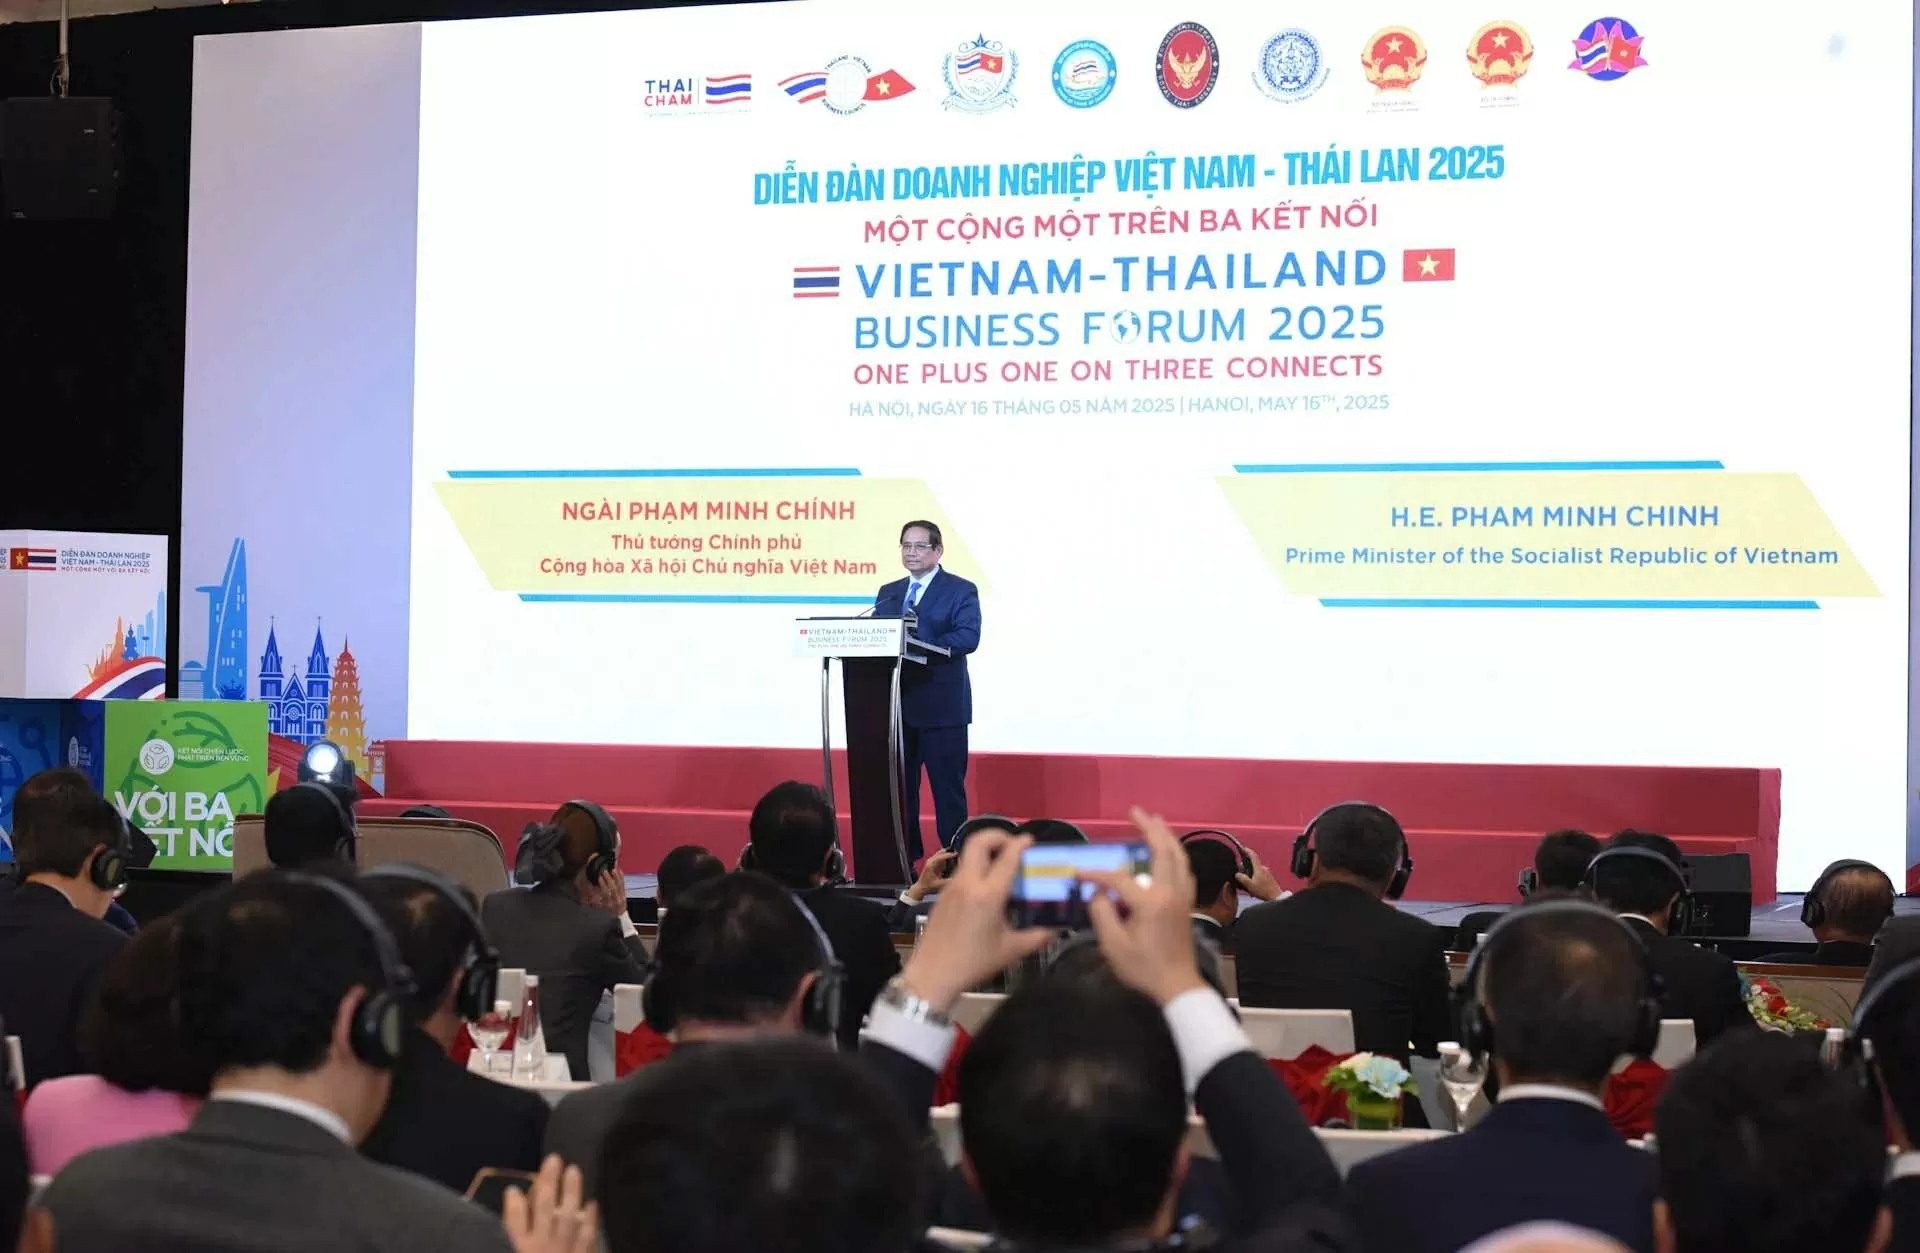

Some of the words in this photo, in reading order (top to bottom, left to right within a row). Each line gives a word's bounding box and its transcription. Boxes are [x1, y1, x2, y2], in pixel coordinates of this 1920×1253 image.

[645, 79, 692, 93] THAI
[644, 94, 692, 106] CHAM
[754, 160, 818, 205] DIỄN
[826, 163, 884, 202] ĐÀN
[893, 164, 990, 200] DOANH
[999, 153, 1105, 201] NGHIỆP
[1115, 151, 1175, 198] VIỆT
[1183, 154, 1255, 189] NAM
[1284, 143, 1350, 186] THÁI
[1360, 148, 1420, 183] LAN
[1428, 144, 1504, 180] 2025
[864, 215, 928, 246] MỘT
[937, 213, 1025, 244] CỘNG
[1034, 209, 1101, 241] MỘT
[1110, 206, 1189, 235] TRÊN
[1200, 208, 1242, 231] BA
[1252, 199, 1311, 229] KẾT
[1321, 196, 1377, 228] NỐI
[856, 250, 1385, 298] VIETNAM-THAILAND
[856, 313, 1059, 348] BUSINESS
[1084, 308, 1244, 344] FORUM
[1269, 305, 1384, 340] 2025
[854, 364, 909, 384] ONE
[922, 362, 987, 384] PLUS
[1001, 361, 1058, 382] ONE
[1071, 360, 1111, 381] ON
[1125, 358, 1213, 380] THREE
[1227, 354, 1382, 378] CONNECTS
[918, 400, 967, 416] NGÀY
[972, 401, 987, 415] 16
[992, 397, 1055, 415] THÁNG
[1059, 400, 1081, 414] 05
[1132, 398, 1175, 413] 2025
[1188, 396, 1254, 413] HANOI,
[1258, 396, 1298, 411] MAY
[1344, 395, 1389, 410] 2025
[563, 498, 621, 521] NGÀI
[629, 501, 698, 524] PHẠM
[706, 501, 768, 520] MINH
[776, 498, 855, 520] CHÍNH
[1392, 507, 1442, 527] H.E.
[1452, 507, 1533, 527] PHAM
[1544, 506, 1616, 527] MINH
[1626, 506, 1718, 526] CHINH
[611, 533, 644, 550] Thủ
[650, 534, 703, 552] tướng
[709, 534, 761, 550] Chính
[767, 533, 802, 552] phủ
[61, 548, 78, 558] DIỄN
[80, 550, 96, 558] ĐÀN
[124, 551, 150, 559] NGHIỆP
[1286, 548, 1345, 564] Prime
[1353, 548, 1436, 564] Minister
[1443, 547, 1464, 564] of
[1470, 547, 1504, 564] the
[1512, 547, 1602, 564] Socialist
[1610, 547, 1707, 567] Republic
[1715, 547, 1737, 564] of
[1744, 548, 1838, 564] Vietnam
[540, 558, 586, 576] Cộng
[592, 557, 624, 574] hòa
[631, 558, 653, 574] Xã
[659, 558, 686, 576] hội
[692, 558, 727, 574] Chủ
[733, 558, 784, 576] nghĩa
[790, 559, 827, 577] Việt
[834, 559, 876, 574] Nam
[114, 784, 176, 821] VỚI
[185, 792, 234, 821] BA
